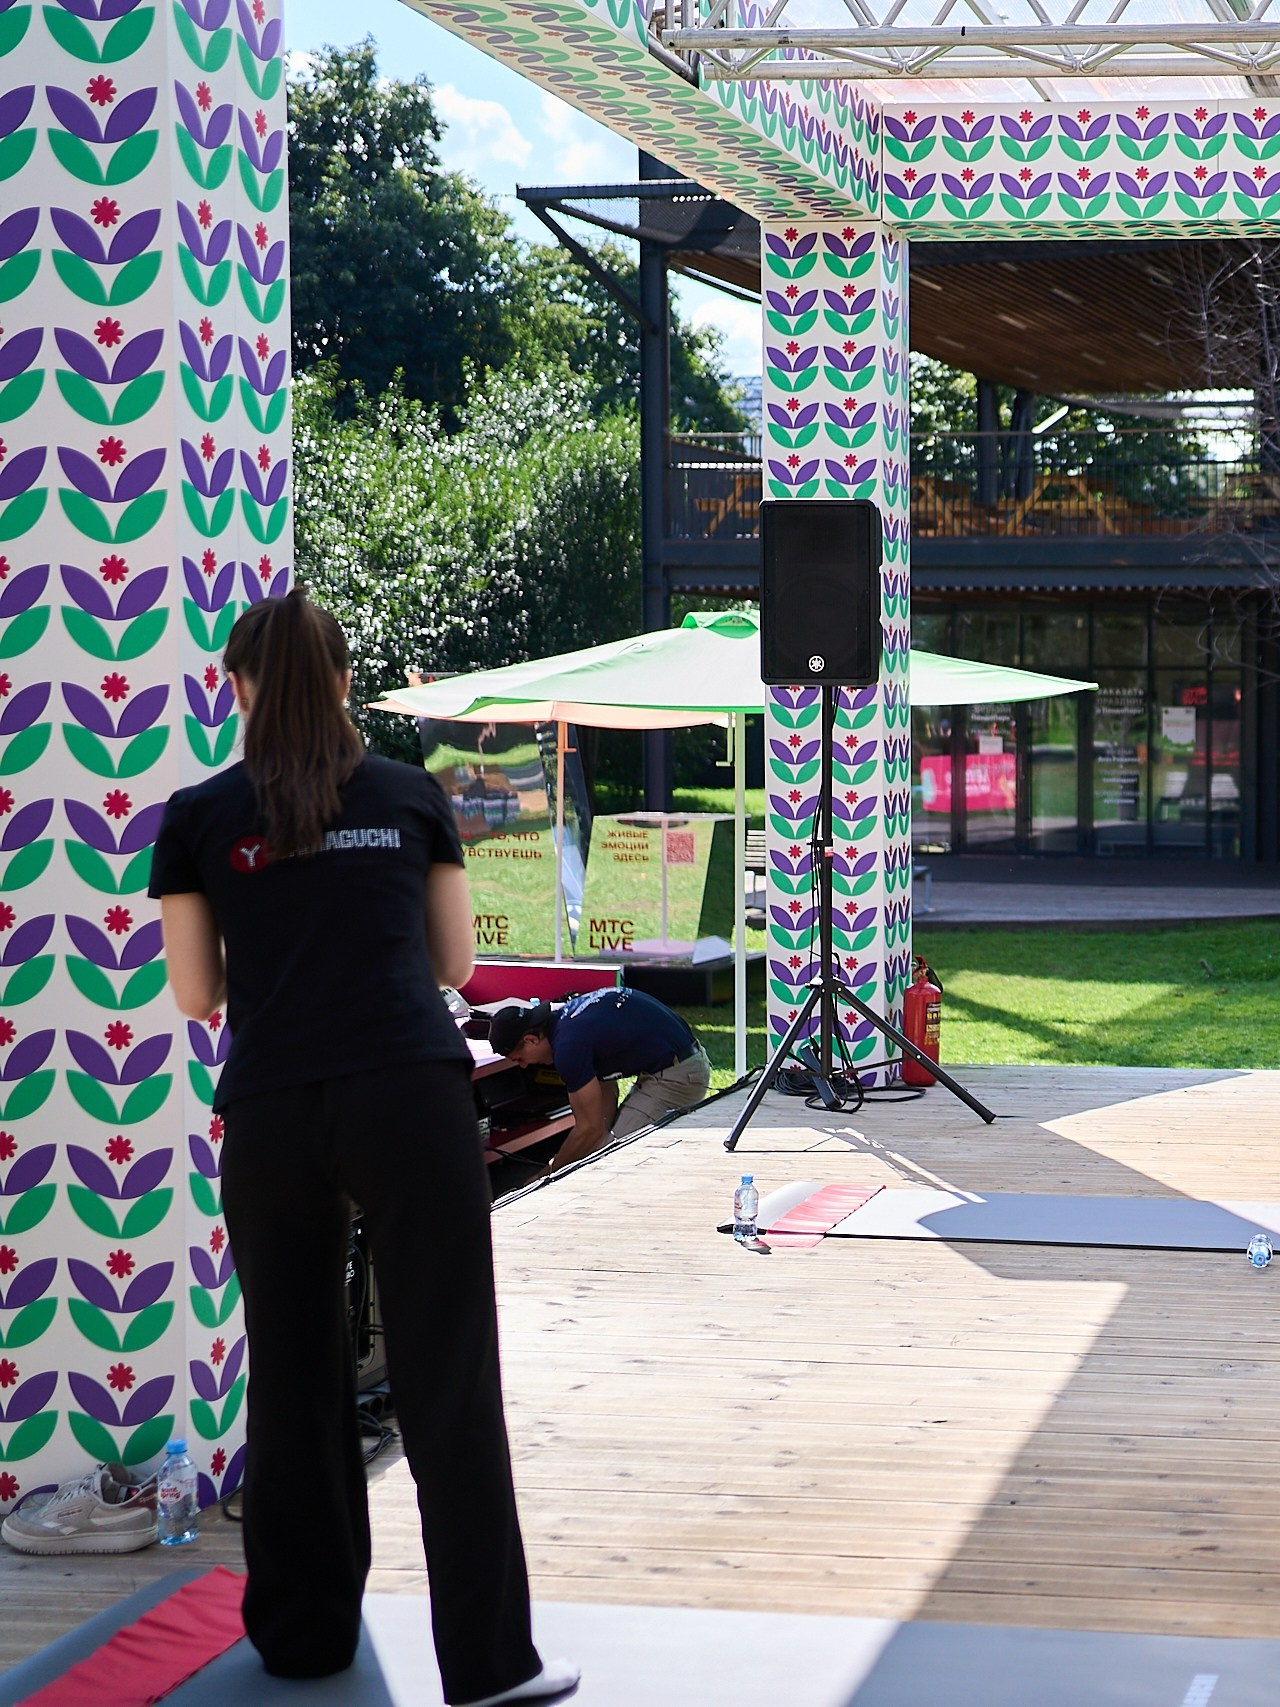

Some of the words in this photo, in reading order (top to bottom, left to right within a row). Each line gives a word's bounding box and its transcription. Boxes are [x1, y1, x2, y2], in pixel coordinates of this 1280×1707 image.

[607, 829, 649, 839] ЖИВЫЕ
[601, 841, 650, 851] ЭМОЦИИ
[461, 847, 542, 859] УВСТВУЕШЬ
[613, 852, 649, 862] ЗДЕСЬ
[476, 931, 508, 945] IVE
[589, 935, 634, 952] LIVE
